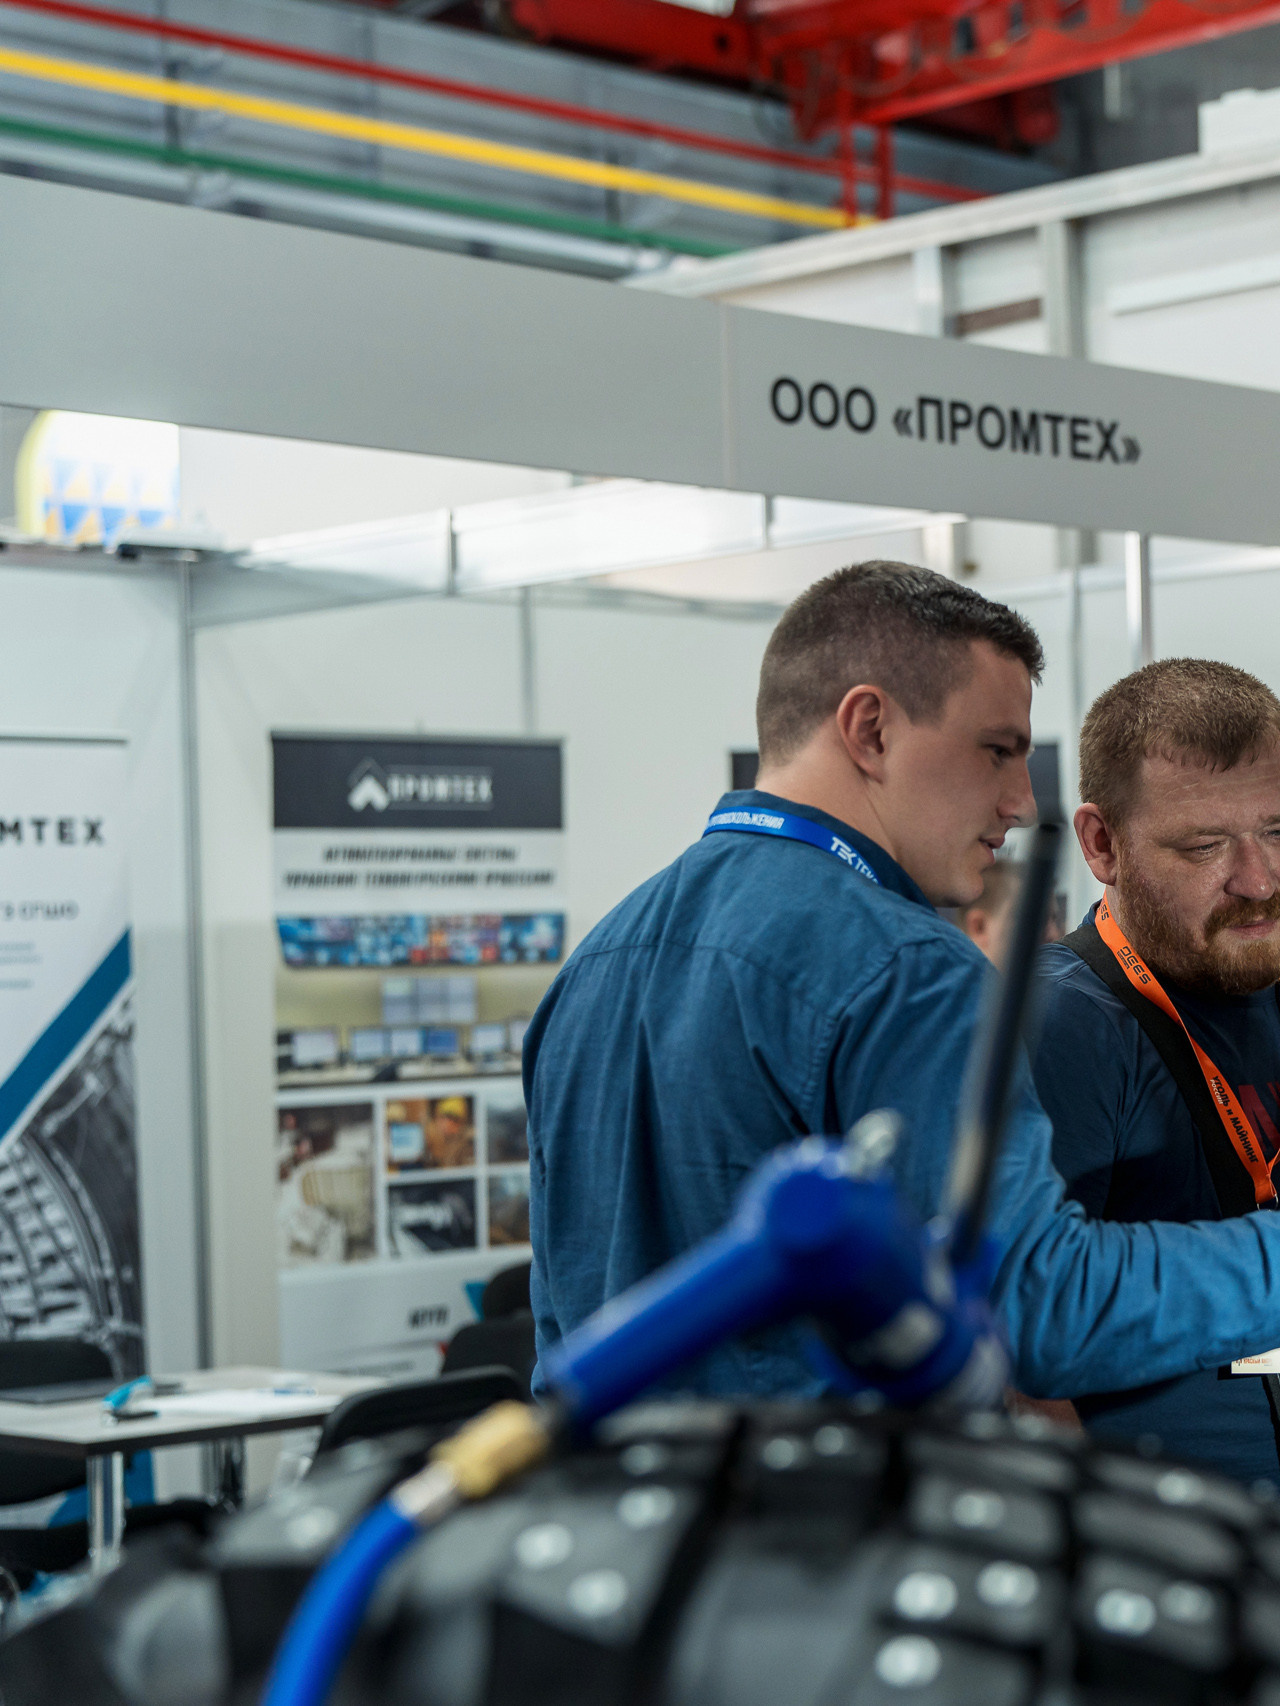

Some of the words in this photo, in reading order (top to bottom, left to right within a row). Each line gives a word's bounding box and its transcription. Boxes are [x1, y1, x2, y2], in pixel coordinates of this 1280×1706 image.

[770, 376, 876, 434] ООО
[892, 395, 1141, 465] «ПРОМТЕХ»
[1213, 1075, 1231, 1107] УГОЛЬ
[1230, 1116, 1259, 1163] МАЙНИНГ
